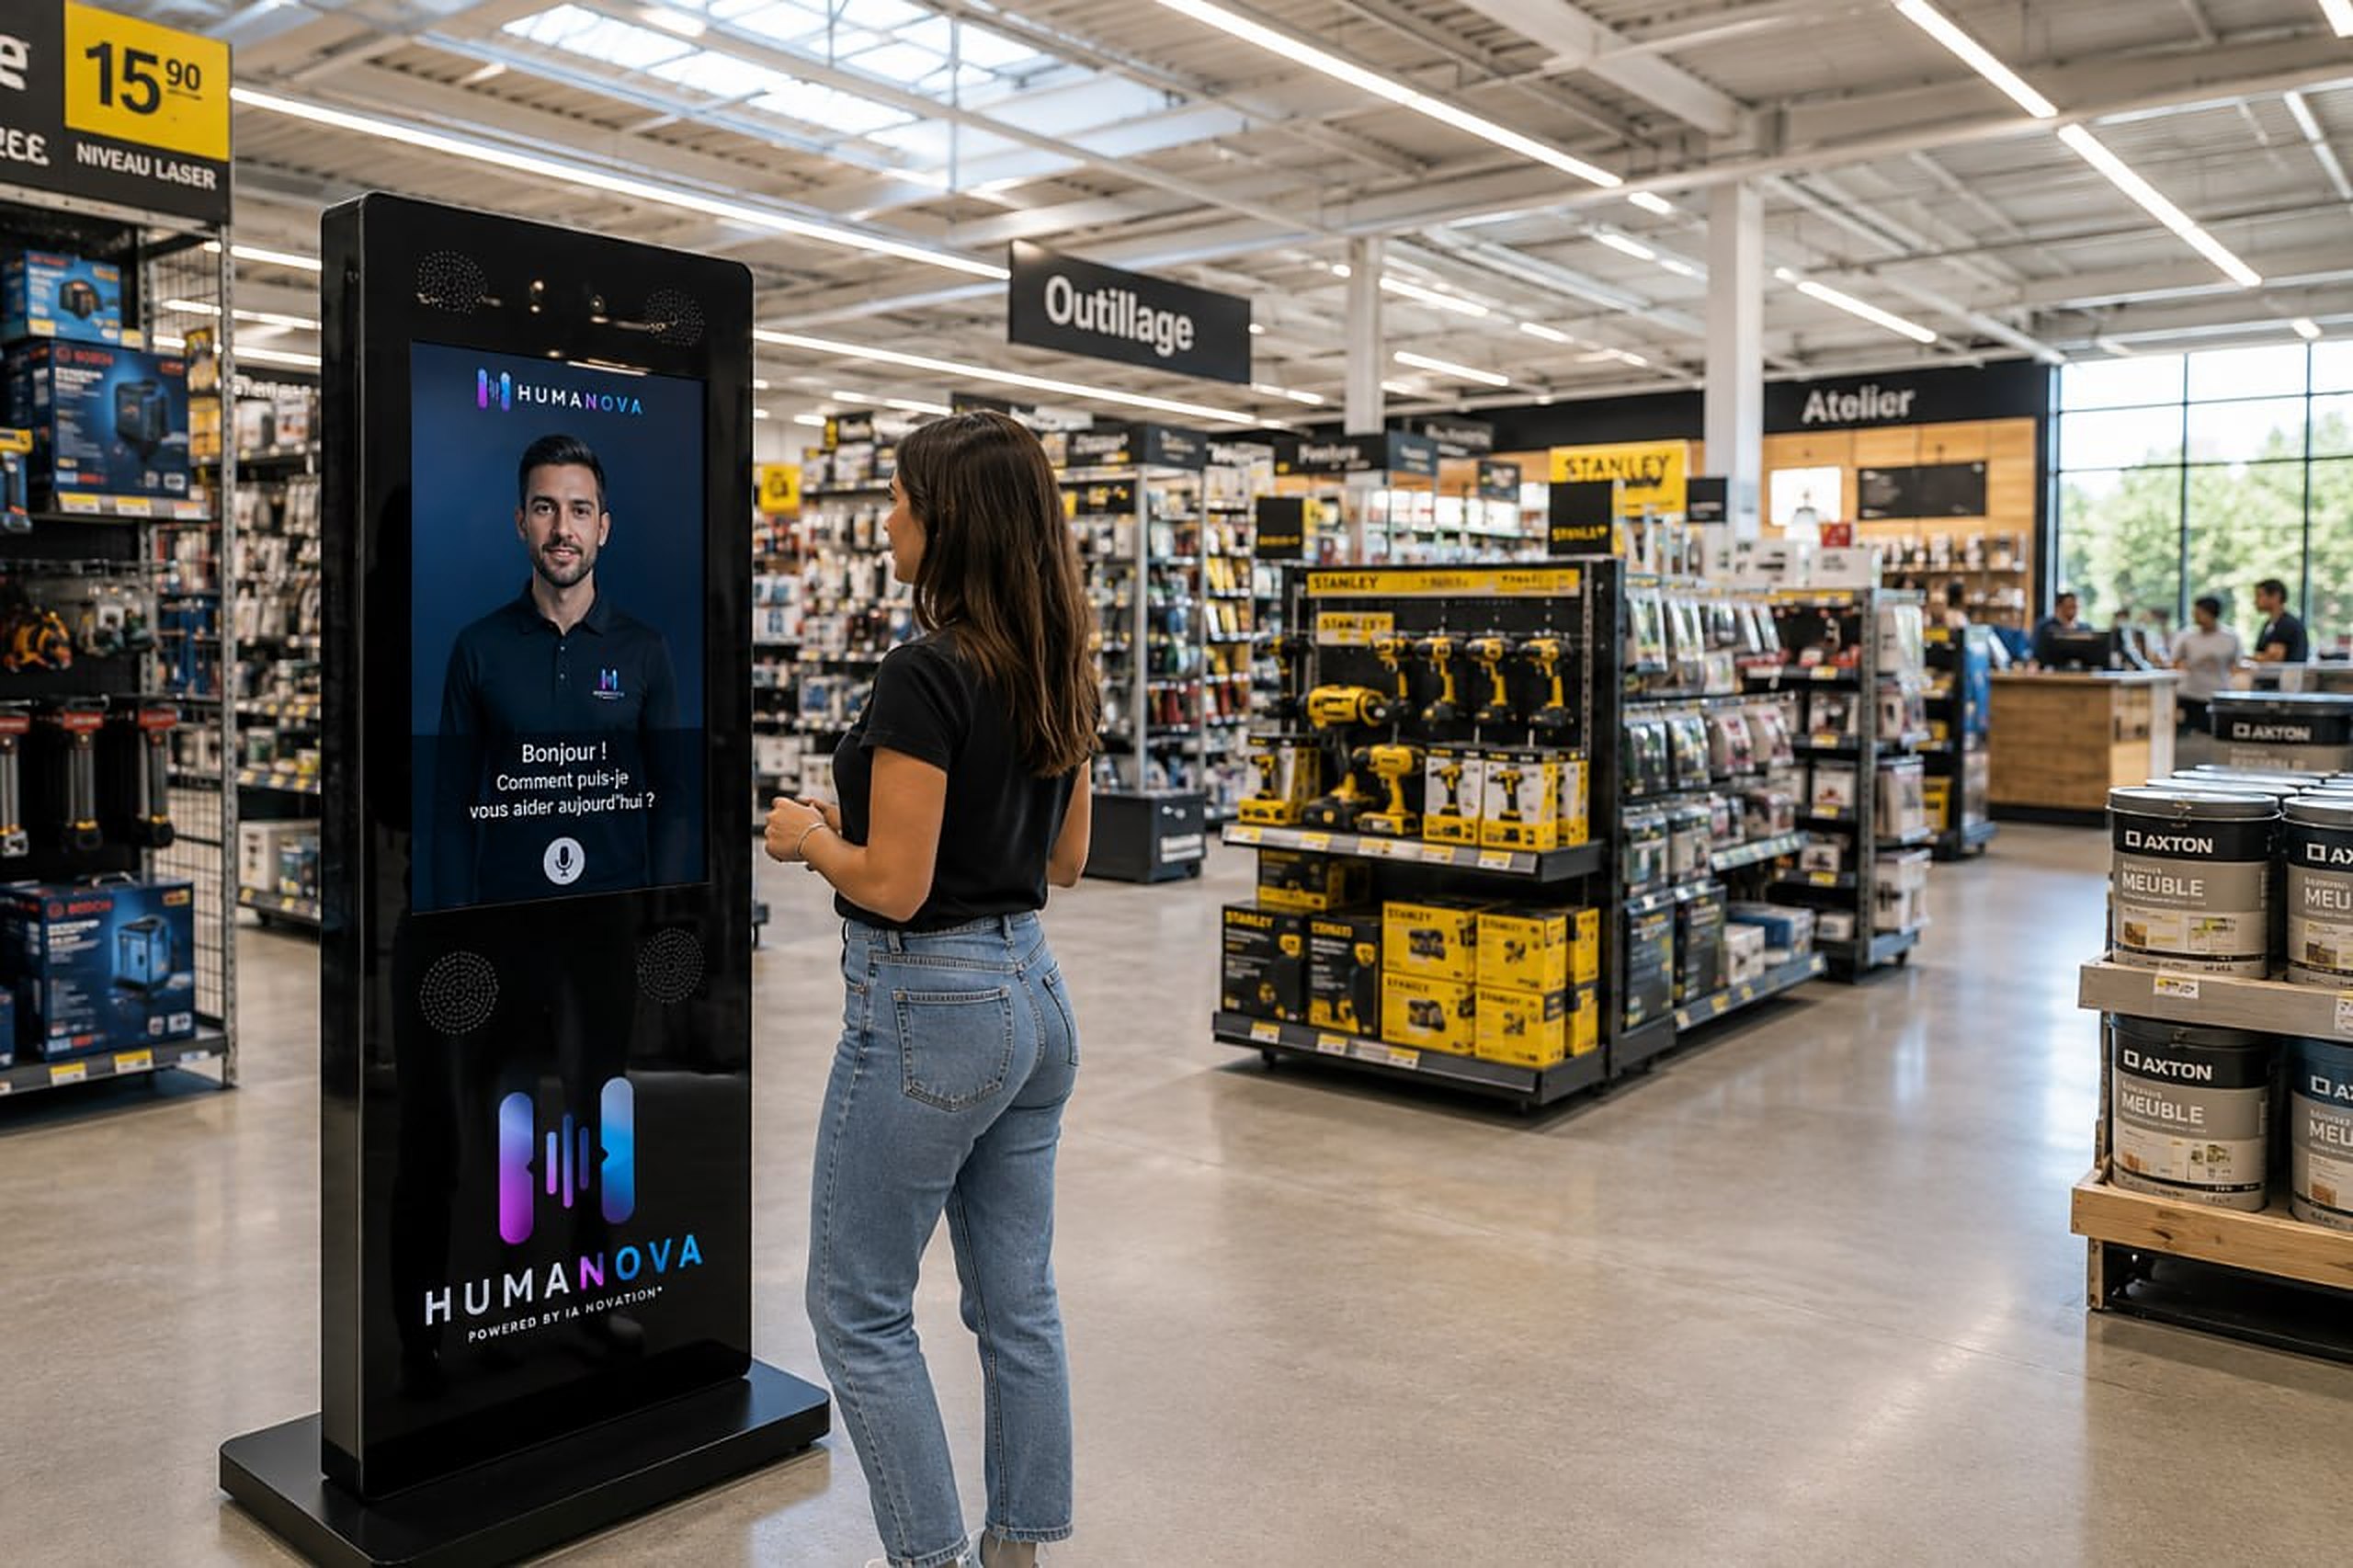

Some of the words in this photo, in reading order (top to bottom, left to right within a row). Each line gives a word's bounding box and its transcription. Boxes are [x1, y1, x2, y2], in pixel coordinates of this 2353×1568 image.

[85, 40, 162, 116] 15
[165, 58, 201, 91] 90
[76, 141, 151, 176] NIVEAU
[155, 158, 217, 190] LASER
[1044, 275, 1195, 357] Outillage
[517, 383, 643, 415] HUMANOVA
[1802, 383, 1915, 424] Atelier
[1564, 454, 1671, 476] STANLEY
[1314, 575, 1379, 589] STANLEY
[522, 742, 597, 767] Bonjour
[496, 773, 574, 791] Comment
[577, 768, 630, 791] puis-je
[469, 805, 509, 820] vous
[512, 799, 555, 817] aider
[558, 792, 643, 817] aujourd'hui
[2144, 835, 2213, 854] AXTON
[2121, 870, 2205, 898] MEUBLE
[2142, 1057, 2212, 1081] AXTON
[2121, 1091, 2205, 1125] MEUBLE
[425, 1233, 704, 1326] HUMANOVA
[468, 1316, 537, 1344] POWERED
[543, 1310, 561, 1325] BY
[565, 1308, 580, 1319] IA
